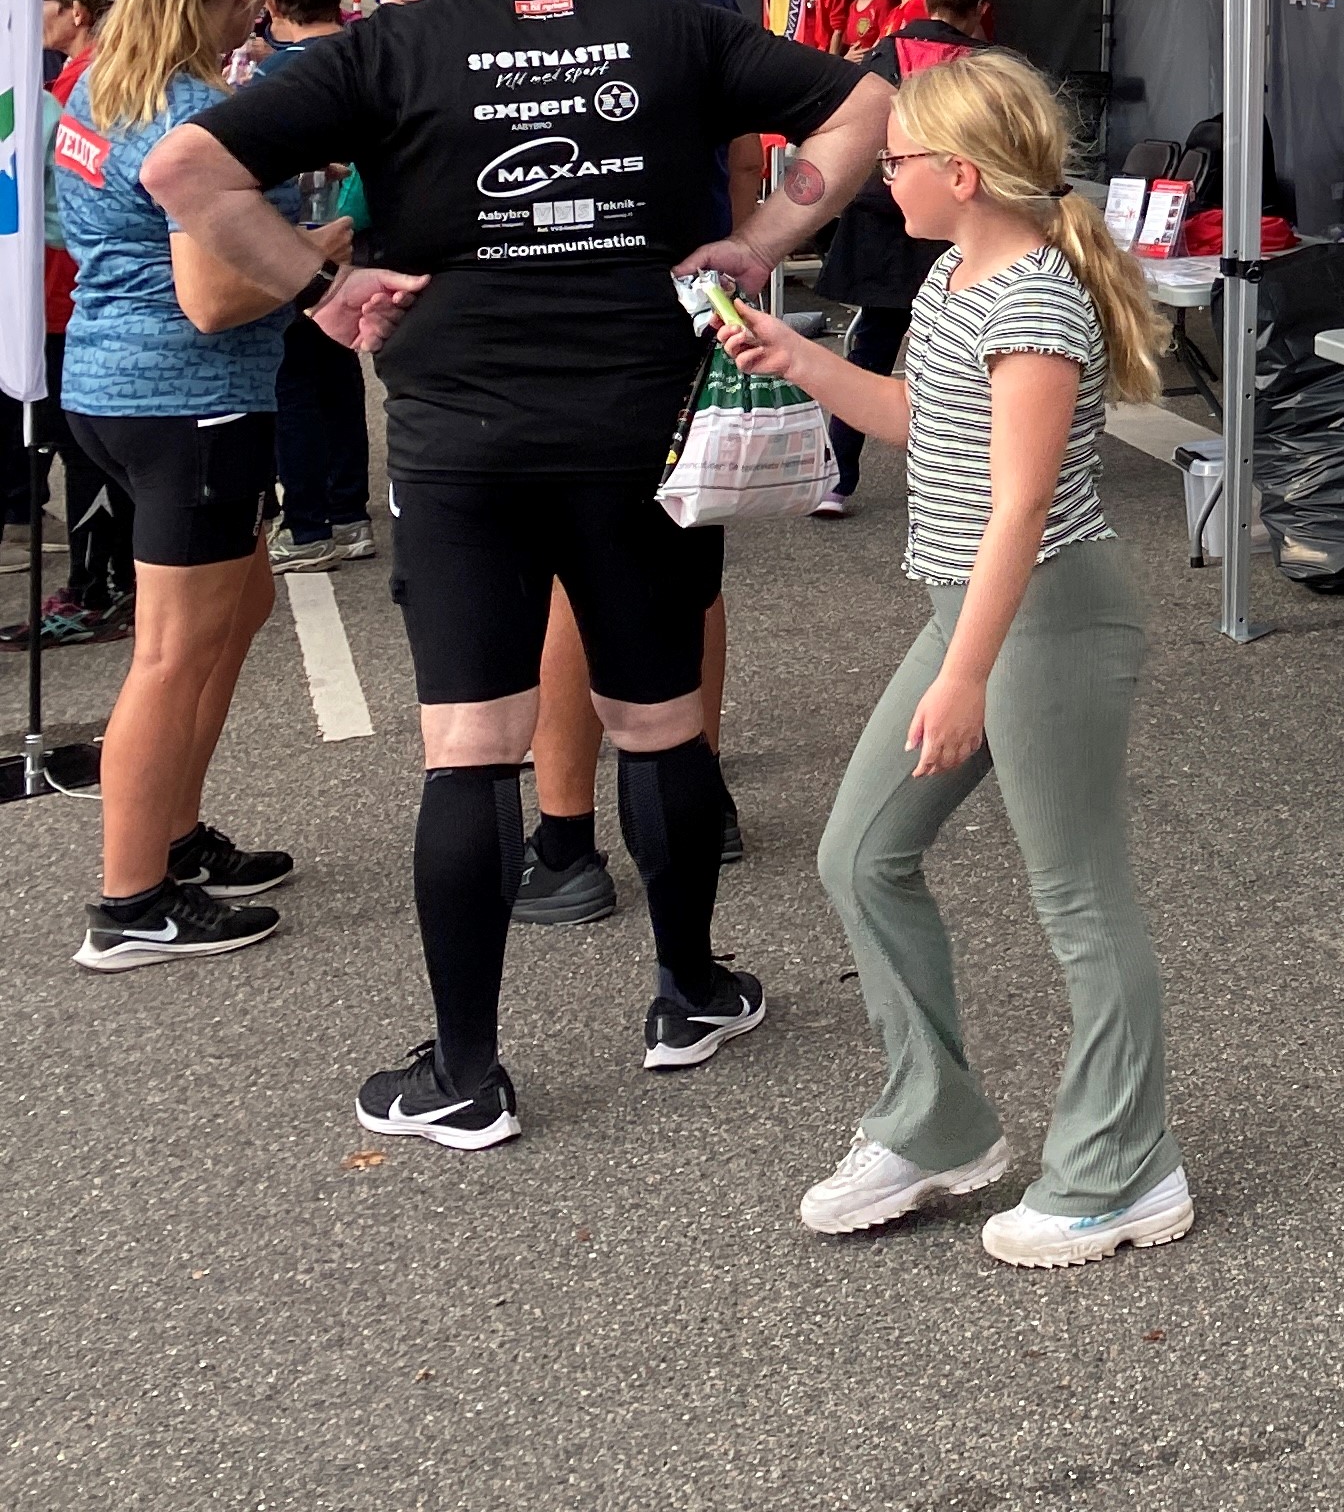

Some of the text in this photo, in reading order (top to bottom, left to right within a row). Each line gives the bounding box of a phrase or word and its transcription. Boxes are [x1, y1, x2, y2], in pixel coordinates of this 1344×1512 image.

[467, 42, 632, 71] SPORTMASTER
[564, 61, 610, 83] sport
[473, 95, 587, 121] expert
[55, 124, 101, 175] VELUX
[498, 156, 644, 183] MAXARS
[477, 209, 530, 222] Aabybro
[596, 198, 635, 212] Teknik
